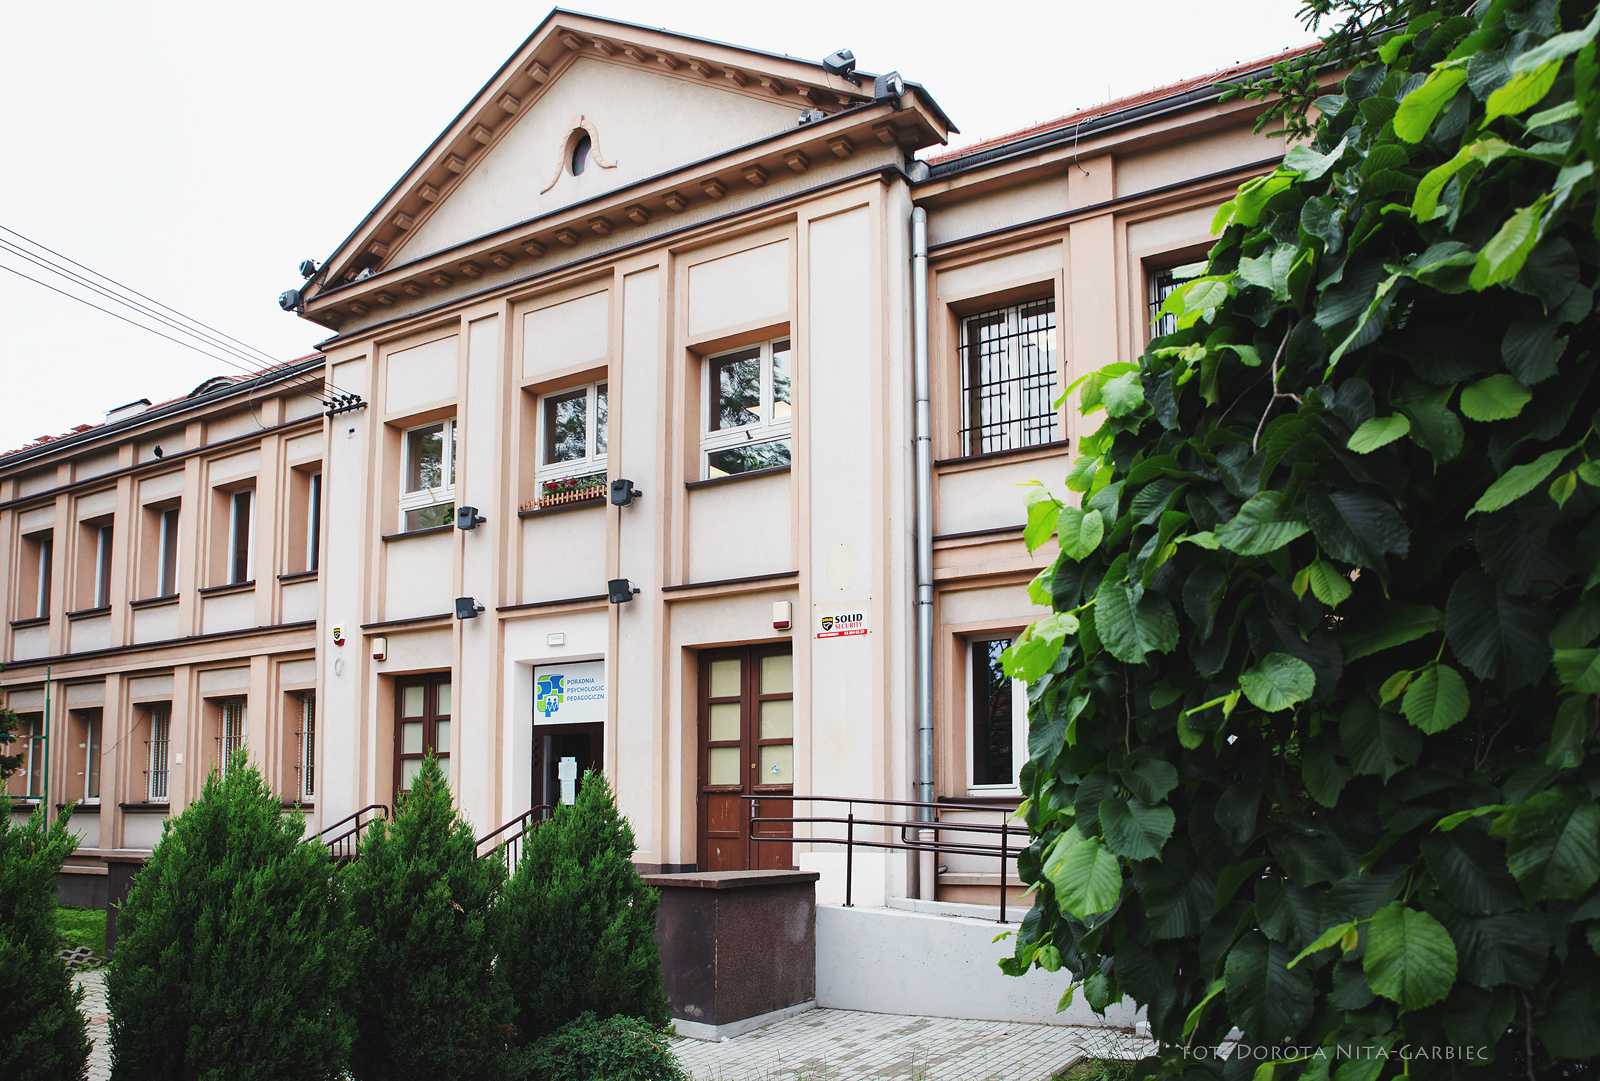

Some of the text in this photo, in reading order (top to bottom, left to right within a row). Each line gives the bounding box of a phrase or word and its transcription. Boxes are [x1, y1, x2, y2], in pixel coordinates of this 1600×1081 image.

[835, 613, 863, 624] SOLID
[835, 622, 862, 630] SECURITY
[566, 685, 604, 693] PSYCHOLOGIC
[566, 694, 604, 702] PEDAGOGICZN
